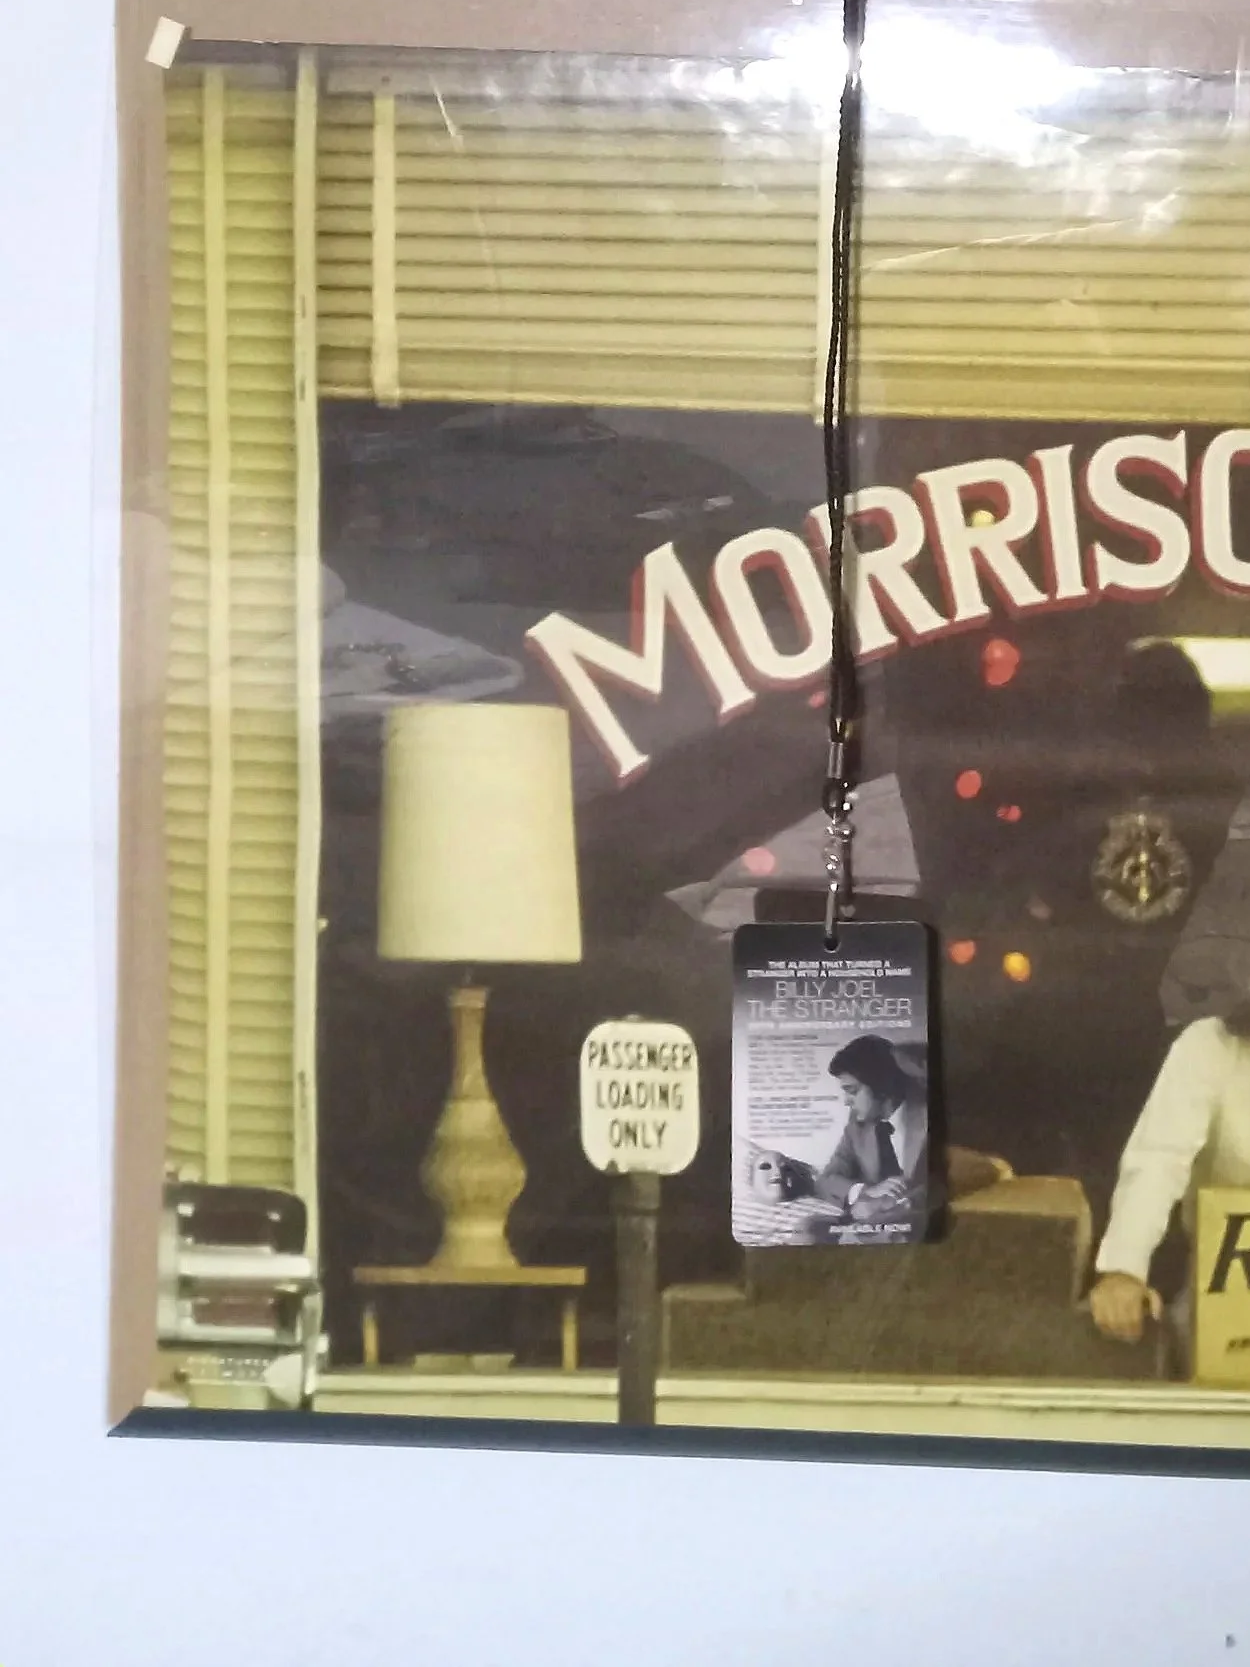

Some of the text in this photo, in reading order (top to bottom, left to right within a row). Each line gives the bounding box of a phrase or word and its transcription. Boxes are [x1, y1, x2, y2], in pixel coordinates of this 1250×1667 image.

[775, 980, 883, 999] BILLY JOEL
[747, 998, 912, 1019] THE STRANGER
[587, 1041, 693, 1072] PASSENGER
[596, 1079, 685, 1111] LOADING
[608, 1120, 667, 1150] ONLY
